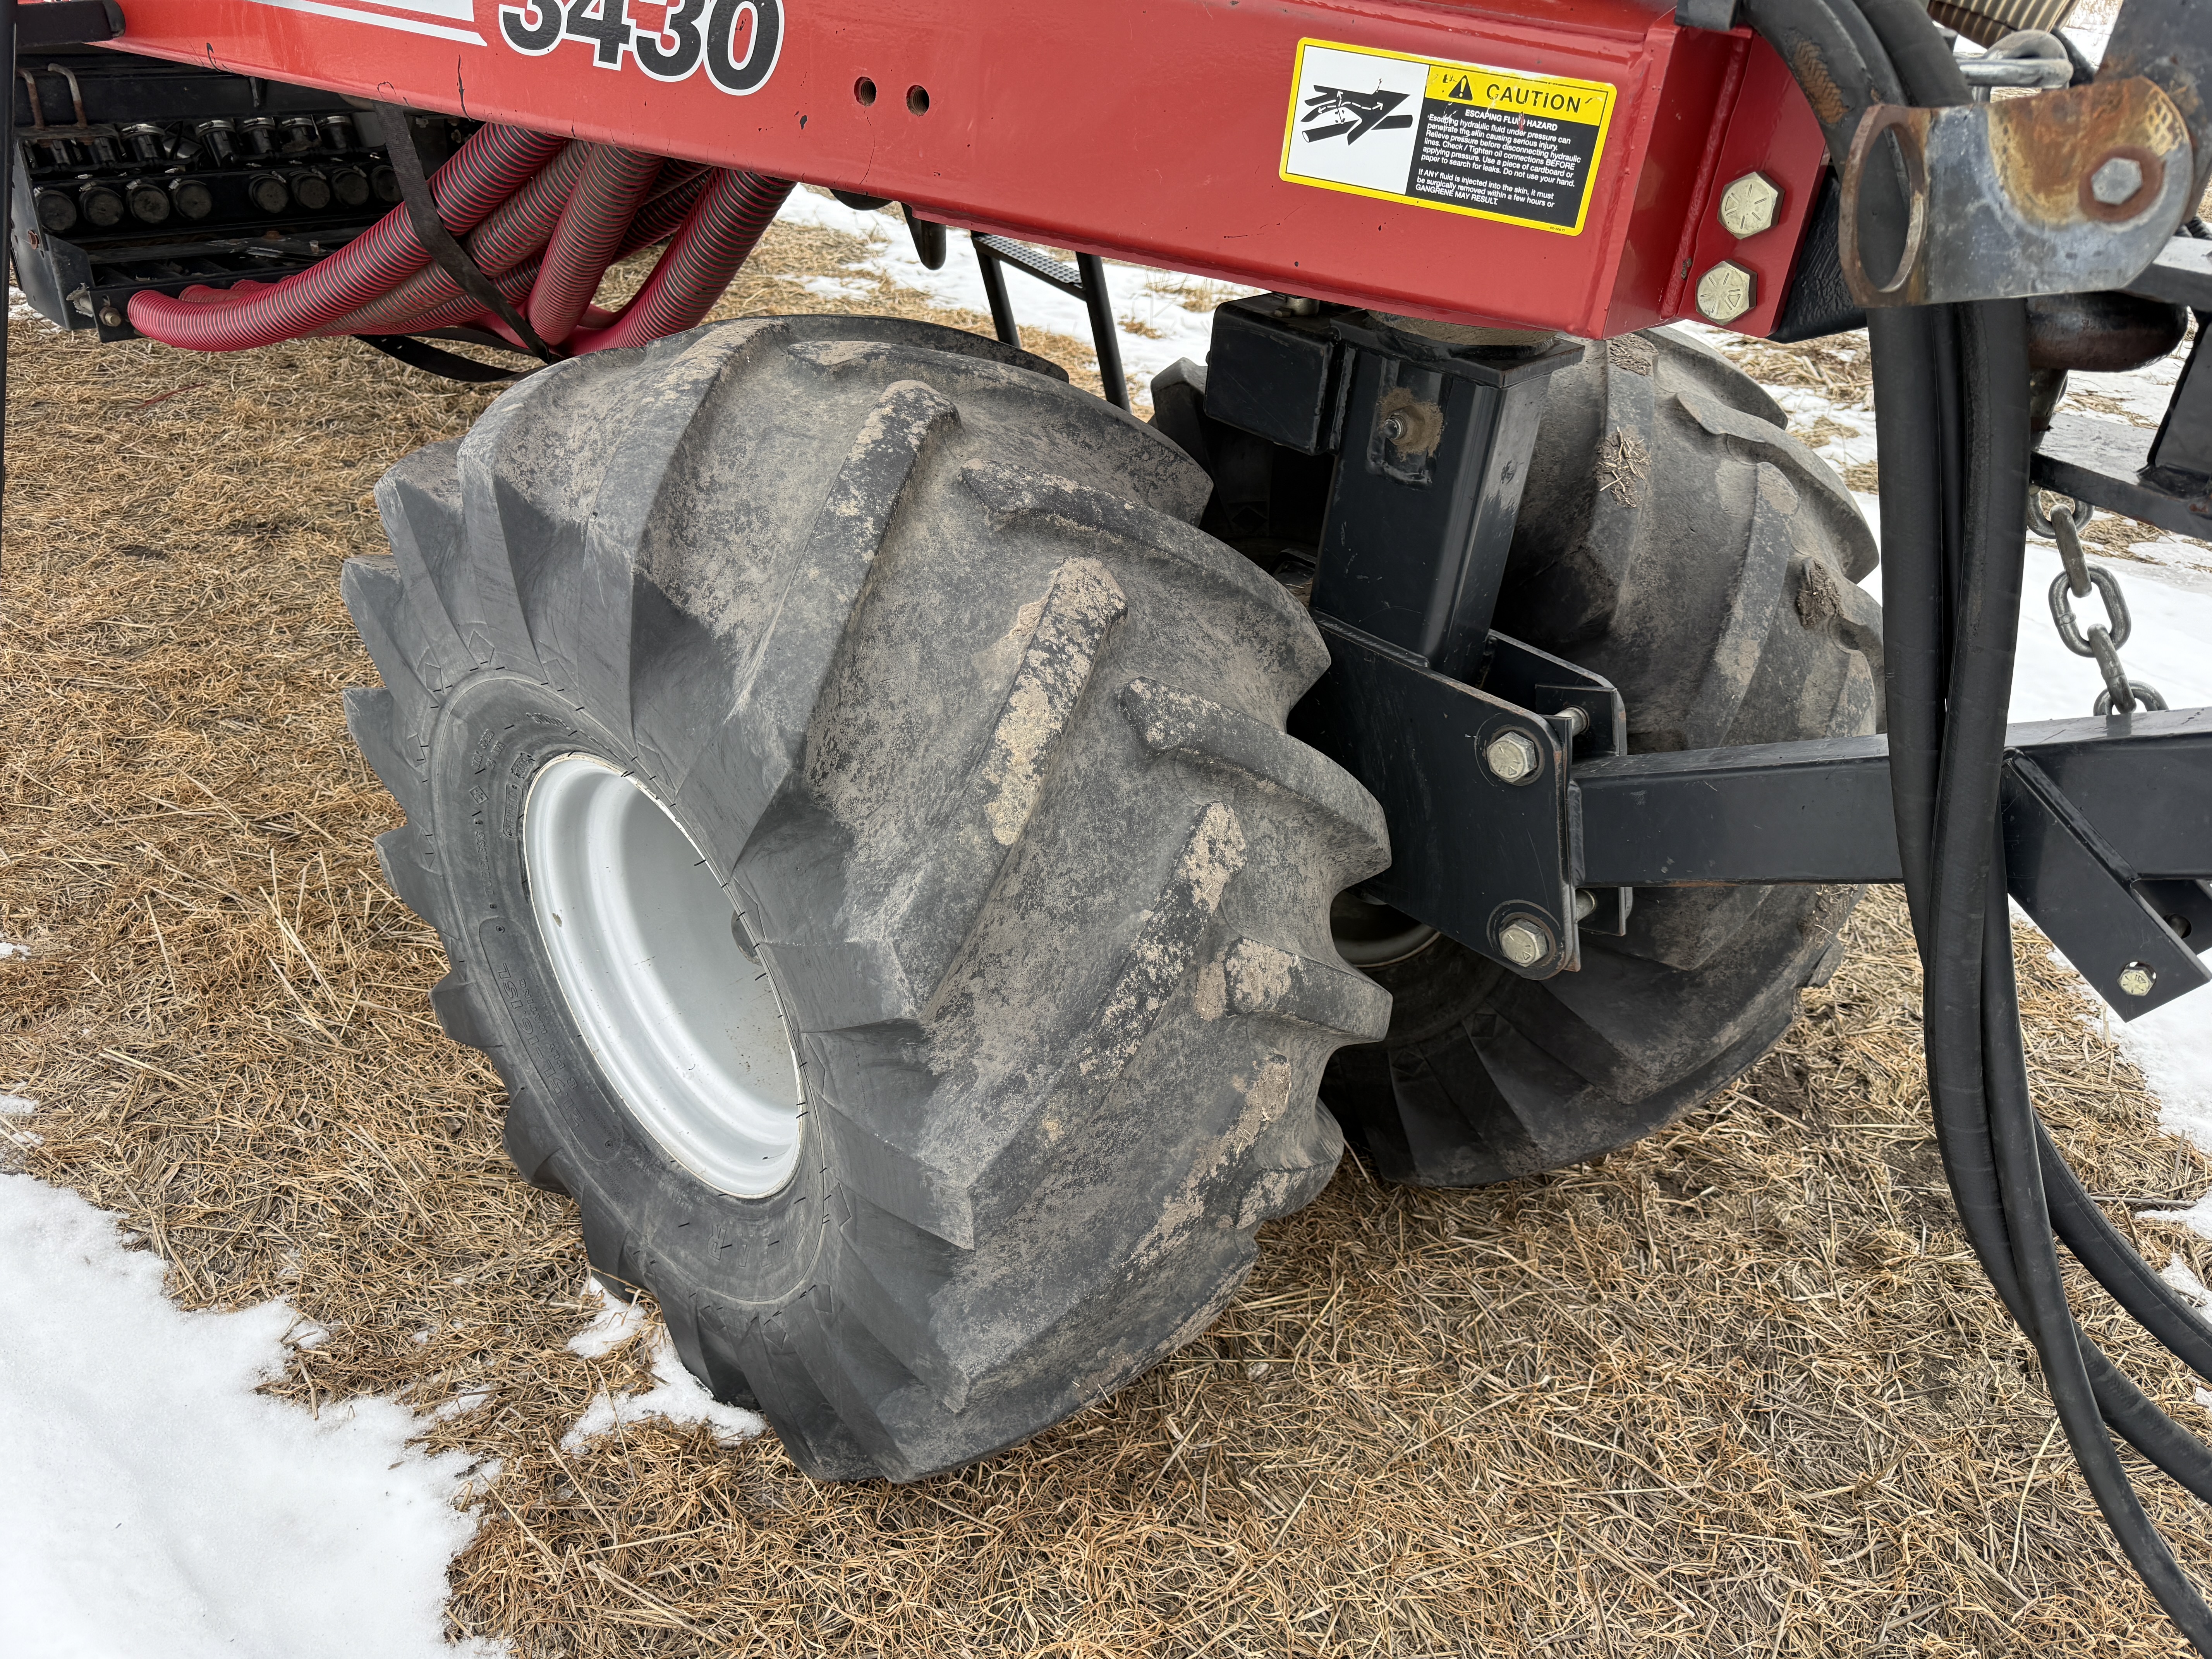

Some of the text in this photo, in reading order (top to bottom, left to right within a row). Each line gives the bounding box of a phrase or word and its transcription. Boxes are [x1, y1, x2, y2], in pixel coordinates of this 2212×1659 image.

[1486, 84, 1581, 113] CAUTION
[1460, 119, 1489, 130] hydraulic
[1491, 124, 1506, 133] fluid
[1527, 132, 1556, 142] pressure
[1465, 109, 1502, 122] ESCAPING
[1526, 119, 1558, 131] HAZARD
[1427, 123, 1458, 133] penetrate
[1459, 127, 1470, 135] the
[1486, 133, 1512, 144] causing
[1513, 137, 1537, 146] serious
[1539, 140, 1558, 151] injury.
[1450, 135, 1478, 145] pressure
[1480, 139, 1501, 148] before
[1502, 143, 1549, 158] disconnecting
[1550, 151, 1581, 163] hydraulic
[1422, 146, 1450, 157] applying
[1451, 151, 1480, 161] pressure.
[1482, 155, 1495, 164] Use
[1502, 160, 1520, 168] piece
[1530, 165, 1565, 176] cardboard
[1424, 137, 1440, 146] lines.
[1442, 141, 1463, 150] Check
[1469, 145, 1493, 155] Tighten
[1503, 153, 1544, 164] connections
[1545, 158, 1575, 170] BEFORE
[1421, 154, 1440, 162] paper
[1449, 159, 1471, 168] search
[1482, 164, 1501, 173] leaks.
[1503, 167, 1513, 175] Do
[1556, 177, 1575, 187] hand.
[1423, 169, 1439, 177] ANY
[1439, 172, 1453, 180] fluid
[1461, 176, 1487, 187] injected
[1488, 181, 1501, 189] into
[1502, 184, 1513, 192] the
[1514, 186, 1529, 196] skin,
[1536, 191, 1554, 199] must
[1415, 184, 1454, 196] GANGRENE
[1455, 191, 1470, 199] MAY
[1426, 179, 1456, 190] surgically
[1457, 185, 1486, 194] removed
[1487, 190, 1506, 198] within
[1526, 196, 1546, 206] hours
[478, 728, 495, 749] SPEED
[475, 831, 495, 896] TUBELESS
[519, 978, 548, 1035] RATING
[498, 963, 585, 1127] 21.5L-16.1SL
[548, 1043, 566, 1069] PLY
